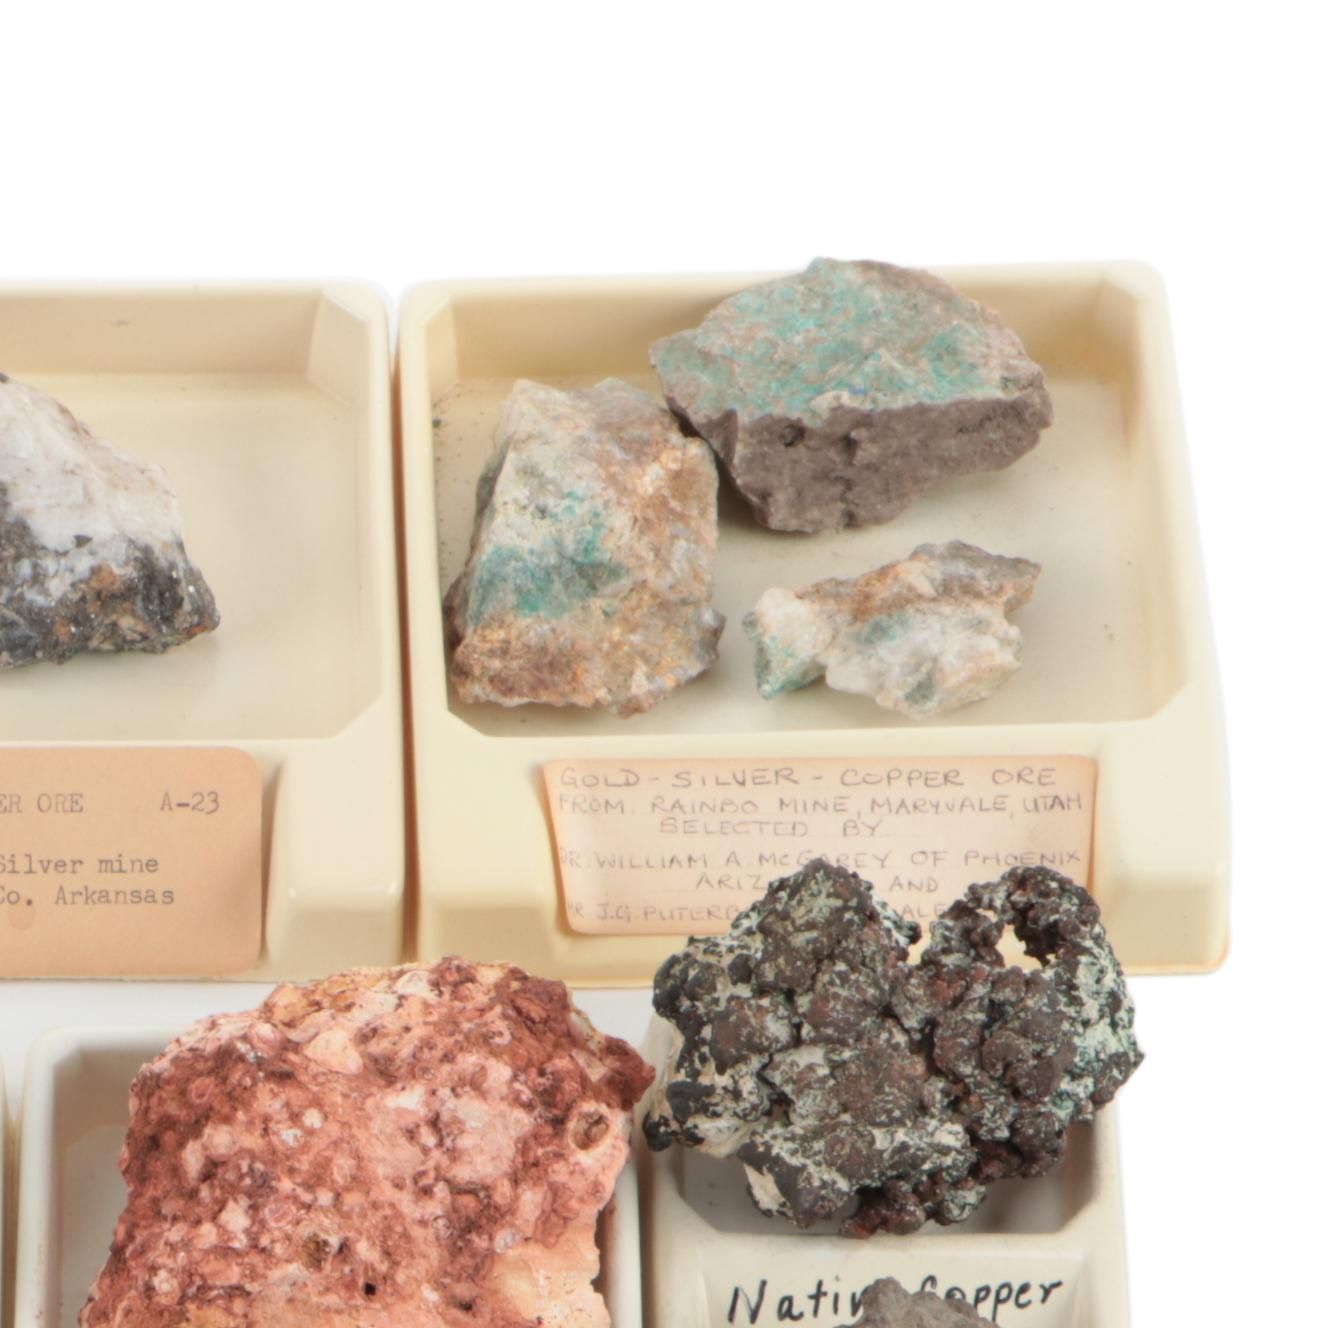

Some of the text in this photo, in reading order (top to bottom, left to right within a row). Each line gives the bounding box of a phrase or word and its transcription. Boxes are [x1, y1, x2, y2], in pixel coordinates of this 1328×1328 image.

[840, 768, 965, 788] COPPER
[991, 767, 1057, 787] ORE
[37, 793, 84, 813] ORE
[160, 792, 220, 815] A-23
[1022, 791, 1083, 812] UTAH
[659, 816, 884, 838] SELECTED BY
[98, 854, 159, 874] mine
[593, 850, 708, 868] WILLIAM
[909, 850, 949, 868] OF
[964, 849, 1081, 868] PHOENIX
[889, 874, 939, 893] AND
[54, 885, 175, 905] Arkansas
[727, 1275, 870, 1325] Nati
